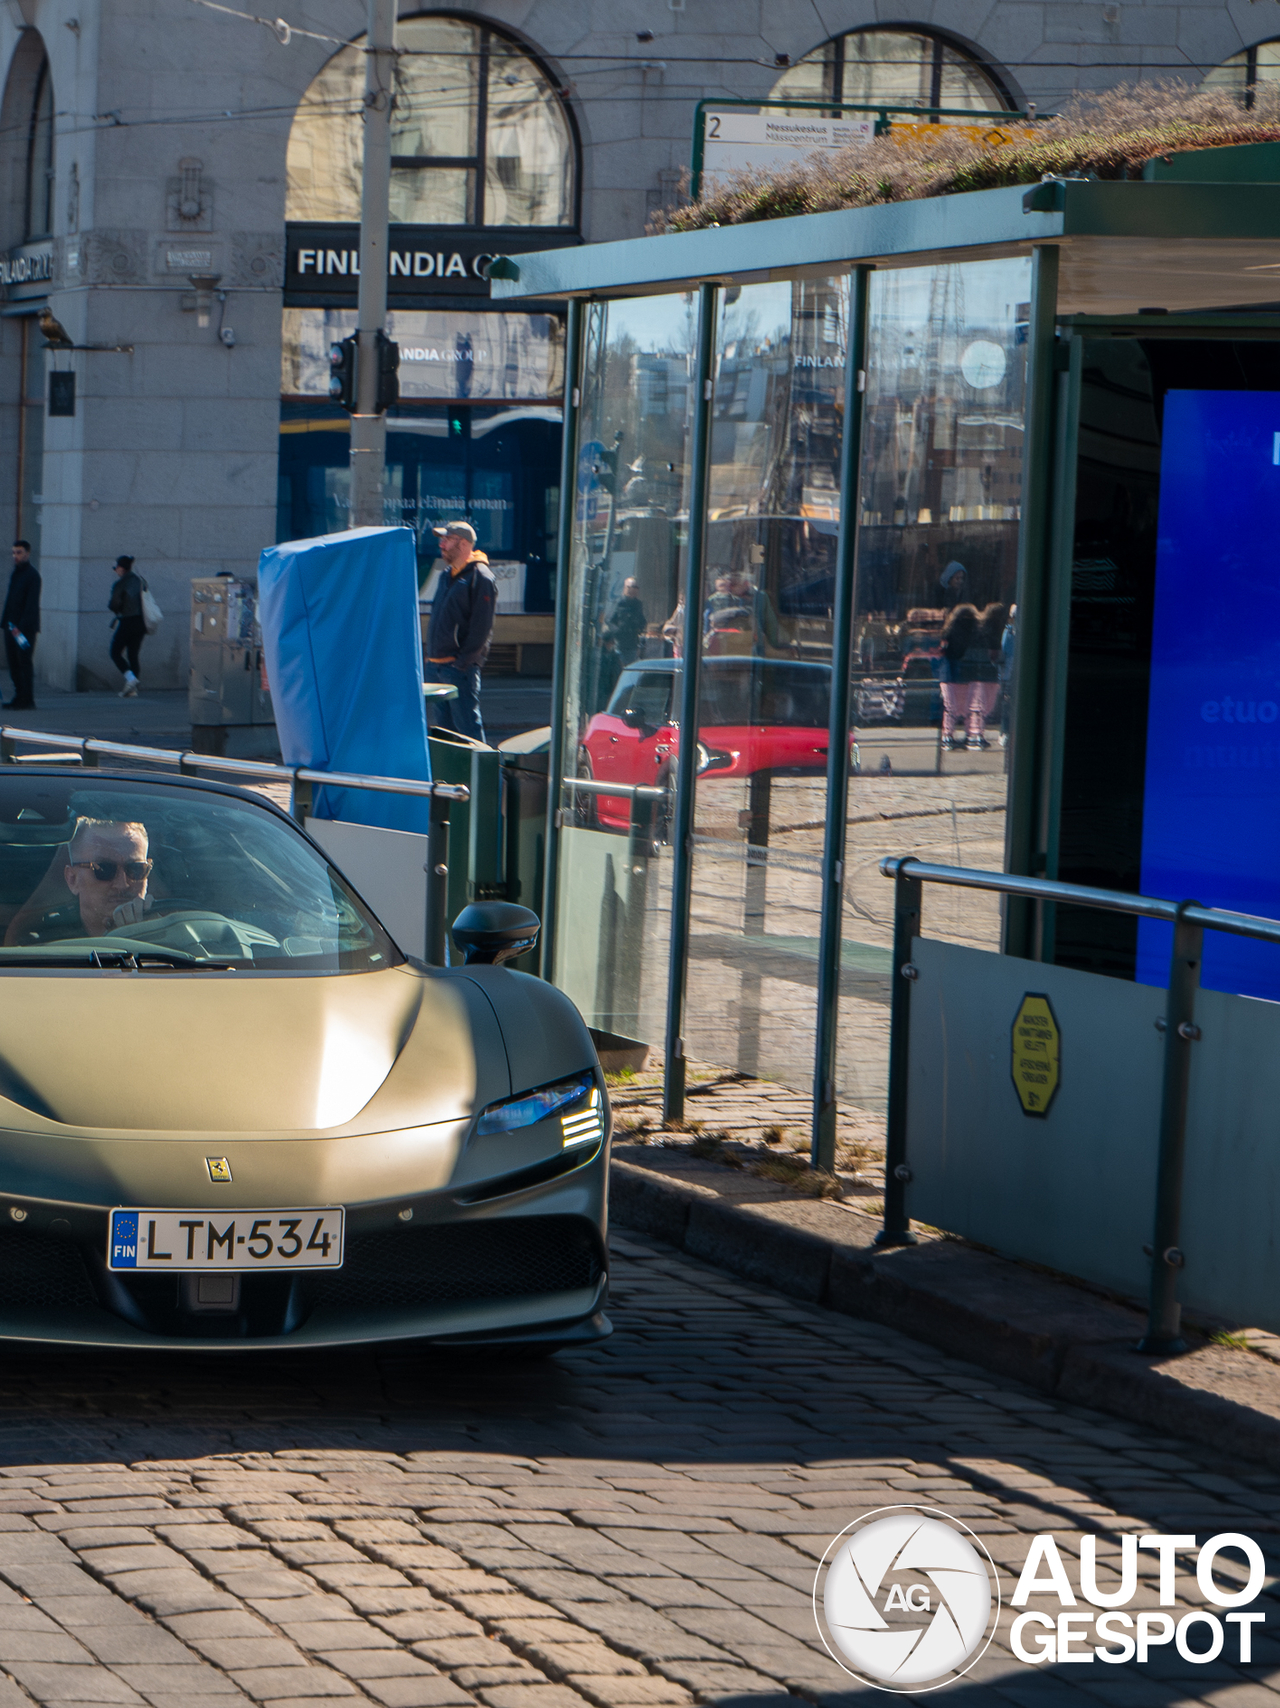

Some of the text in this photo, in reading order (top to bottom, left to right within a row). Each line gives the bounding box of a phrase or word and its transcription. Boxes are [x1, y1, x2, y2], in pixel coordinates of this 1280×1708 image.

[708, 116, 721, 138] 2
[766, 123, 828, 135] Messukeskus
[765, 132, 828, 144] Mässcentrum
[297, 249, 468, 278] FINLNDIA
[398, 347, 487, 362] ANDIA GROUP
[794, 355, 846, 368] FINLAN
[146, 1217, 332, 1260] LTM-534
[114, 1245, 135, 1258] FIN
